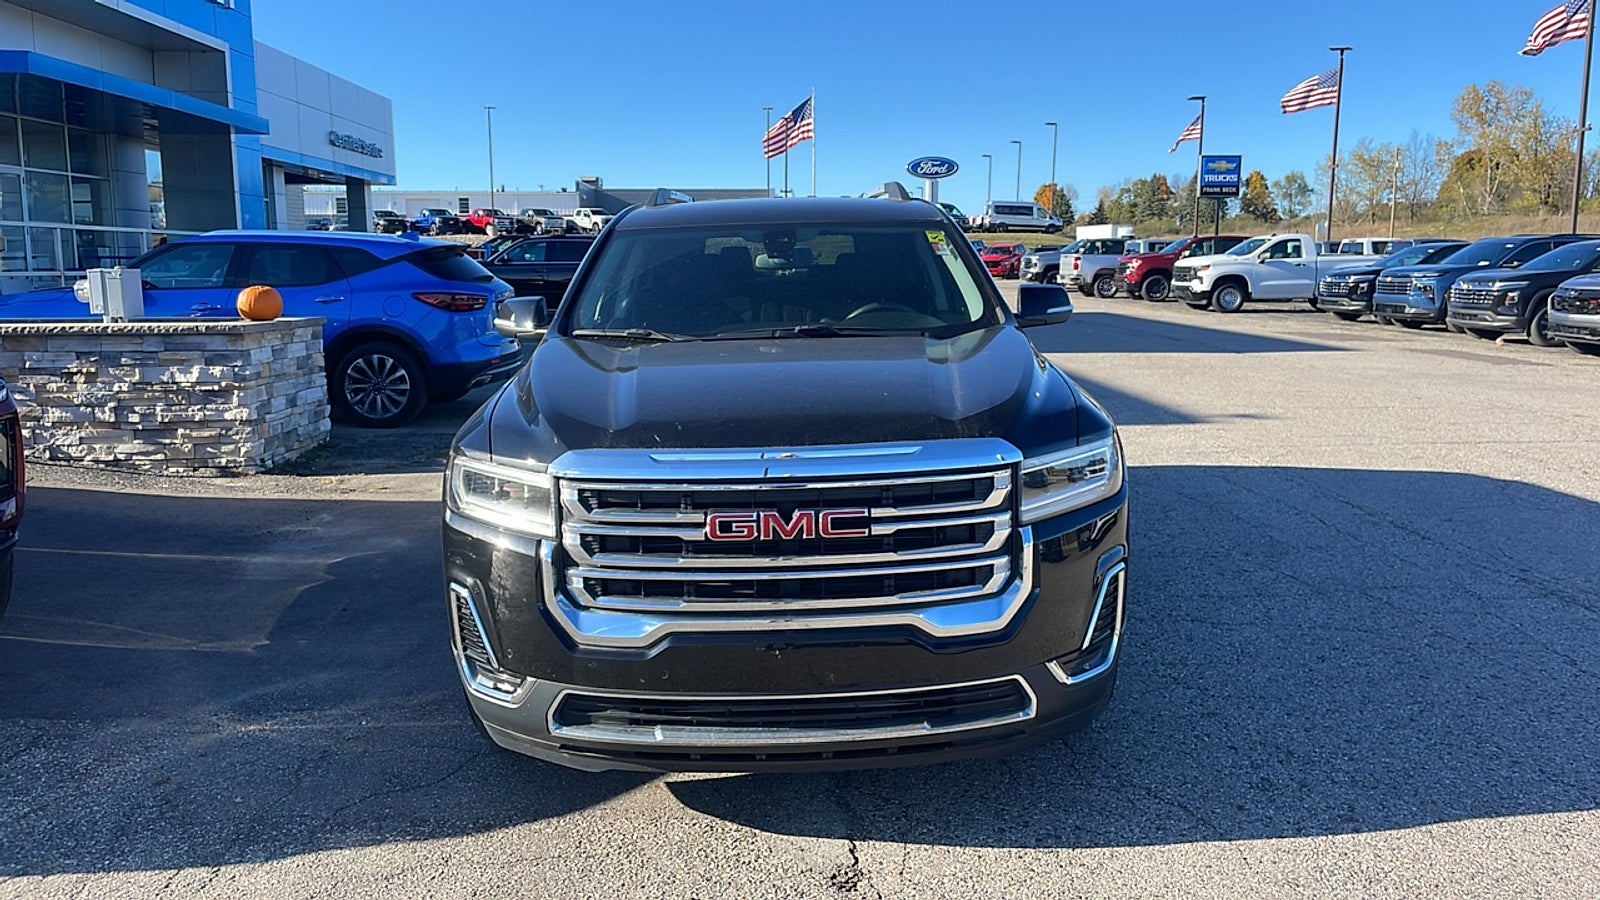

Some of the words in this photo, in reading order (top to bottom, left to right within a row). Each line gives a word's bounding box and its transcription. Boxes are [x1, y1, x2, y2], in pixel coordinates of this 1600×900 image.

[917, 161, 948, 174] Ford
[1204, 174, 1238, 182] TRUCKS
[706, 509, 868, 541] GMC
